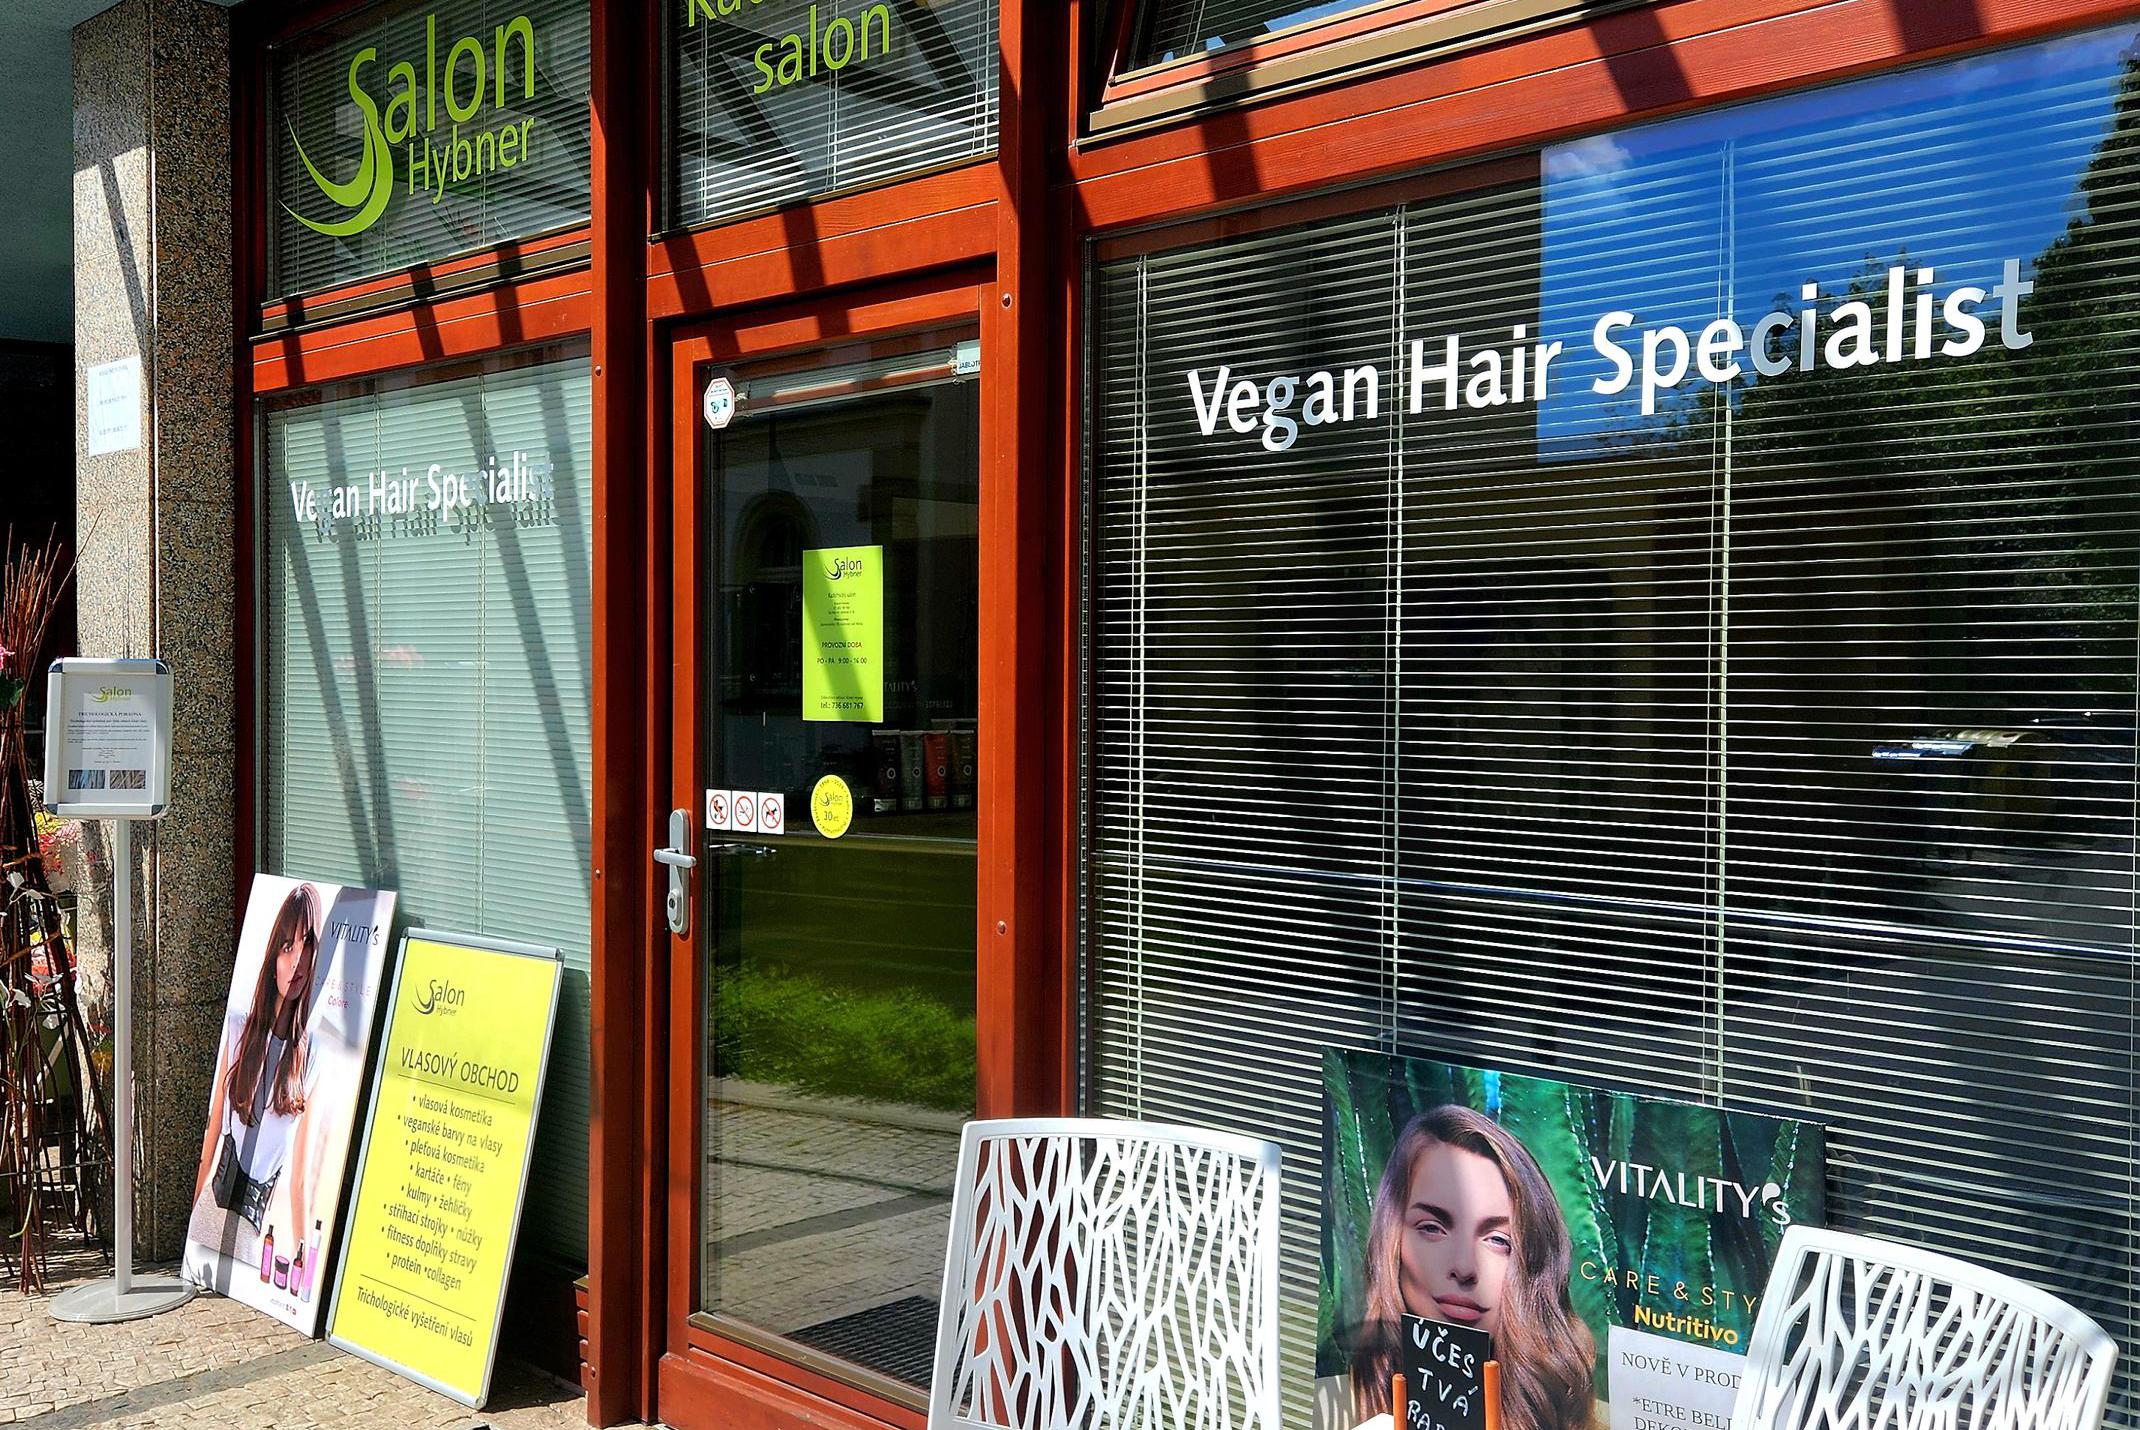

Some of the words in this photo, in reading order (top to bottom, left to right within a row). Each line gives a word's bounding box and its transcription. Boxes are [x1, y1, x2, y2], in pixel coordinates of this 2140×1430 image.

[754, 4, 890, 94] salon
[278, 13, 534, 236] Salon
[408, 117, 534, 204] Hybner
[1188, 361, 1380, 452] Vegan
[1411, 323, 1562, 414] Hair
[1592, 258, 2034, 416] Specialist
[290, 478, 360, 534] Vegan
[369, 466, 419, 515] Hair
[427, 450, 555, 522] Specialist
[823, 556, 862, 581] Salon
[89, 686, 132, 703] Salon
[330, 921, 379, 946] VITALITY's
[410, 979, 465, 1015] Salon
[401, 1047, 458, 1079] VLASOVÝ
[460, 1061, 519, 1093] OBCHOD
[419, 1094, 448, 1115] vlasová
[449, 1101, 493, 1127] kosmetika
[403, 1115, 441, 1136] veganské
[442, 1122, 465, 1147] barvy
[466, 1133, 477, 1147] na
[480, 1134, 503, 1158] vlasy
[409, 1138, 441, 1160] pleťová
[442, 1146, 486, 1174] kosmetika
[415, 1161, 446, 1185] kartáče
[1591, 1155, 1792, 1225] VITALITY's
[406, 1183, 432, 1209] kulmy
[420, 1214, 449, 1239] strojky
[386, 1224, 414, 1248] fitness
[449, 1250, 478, 1275] stravy
[390, 1253, 422, 1276] protein
[1580, 1260, 1661, 1295] CARE
[1672, 1280, 1690, 1301] &
[1701, 1286, 1758, 1315] STY
[357, 1286, 411, 1320] Trichologické
[411, 1308, 450, 1337] vyšetření
[1633, 1303, 1739, 1345] Nutritivo
[1412, 1318, 1475, 1379] ÚČES
[1417, 1366, 1479, 1417] TVÁ
[1620, 1351, 1672, 1376] NOVĚ
[1676, 1362, 1691, 1379] V
[1694, 1366, 1743, 1391] PROD
